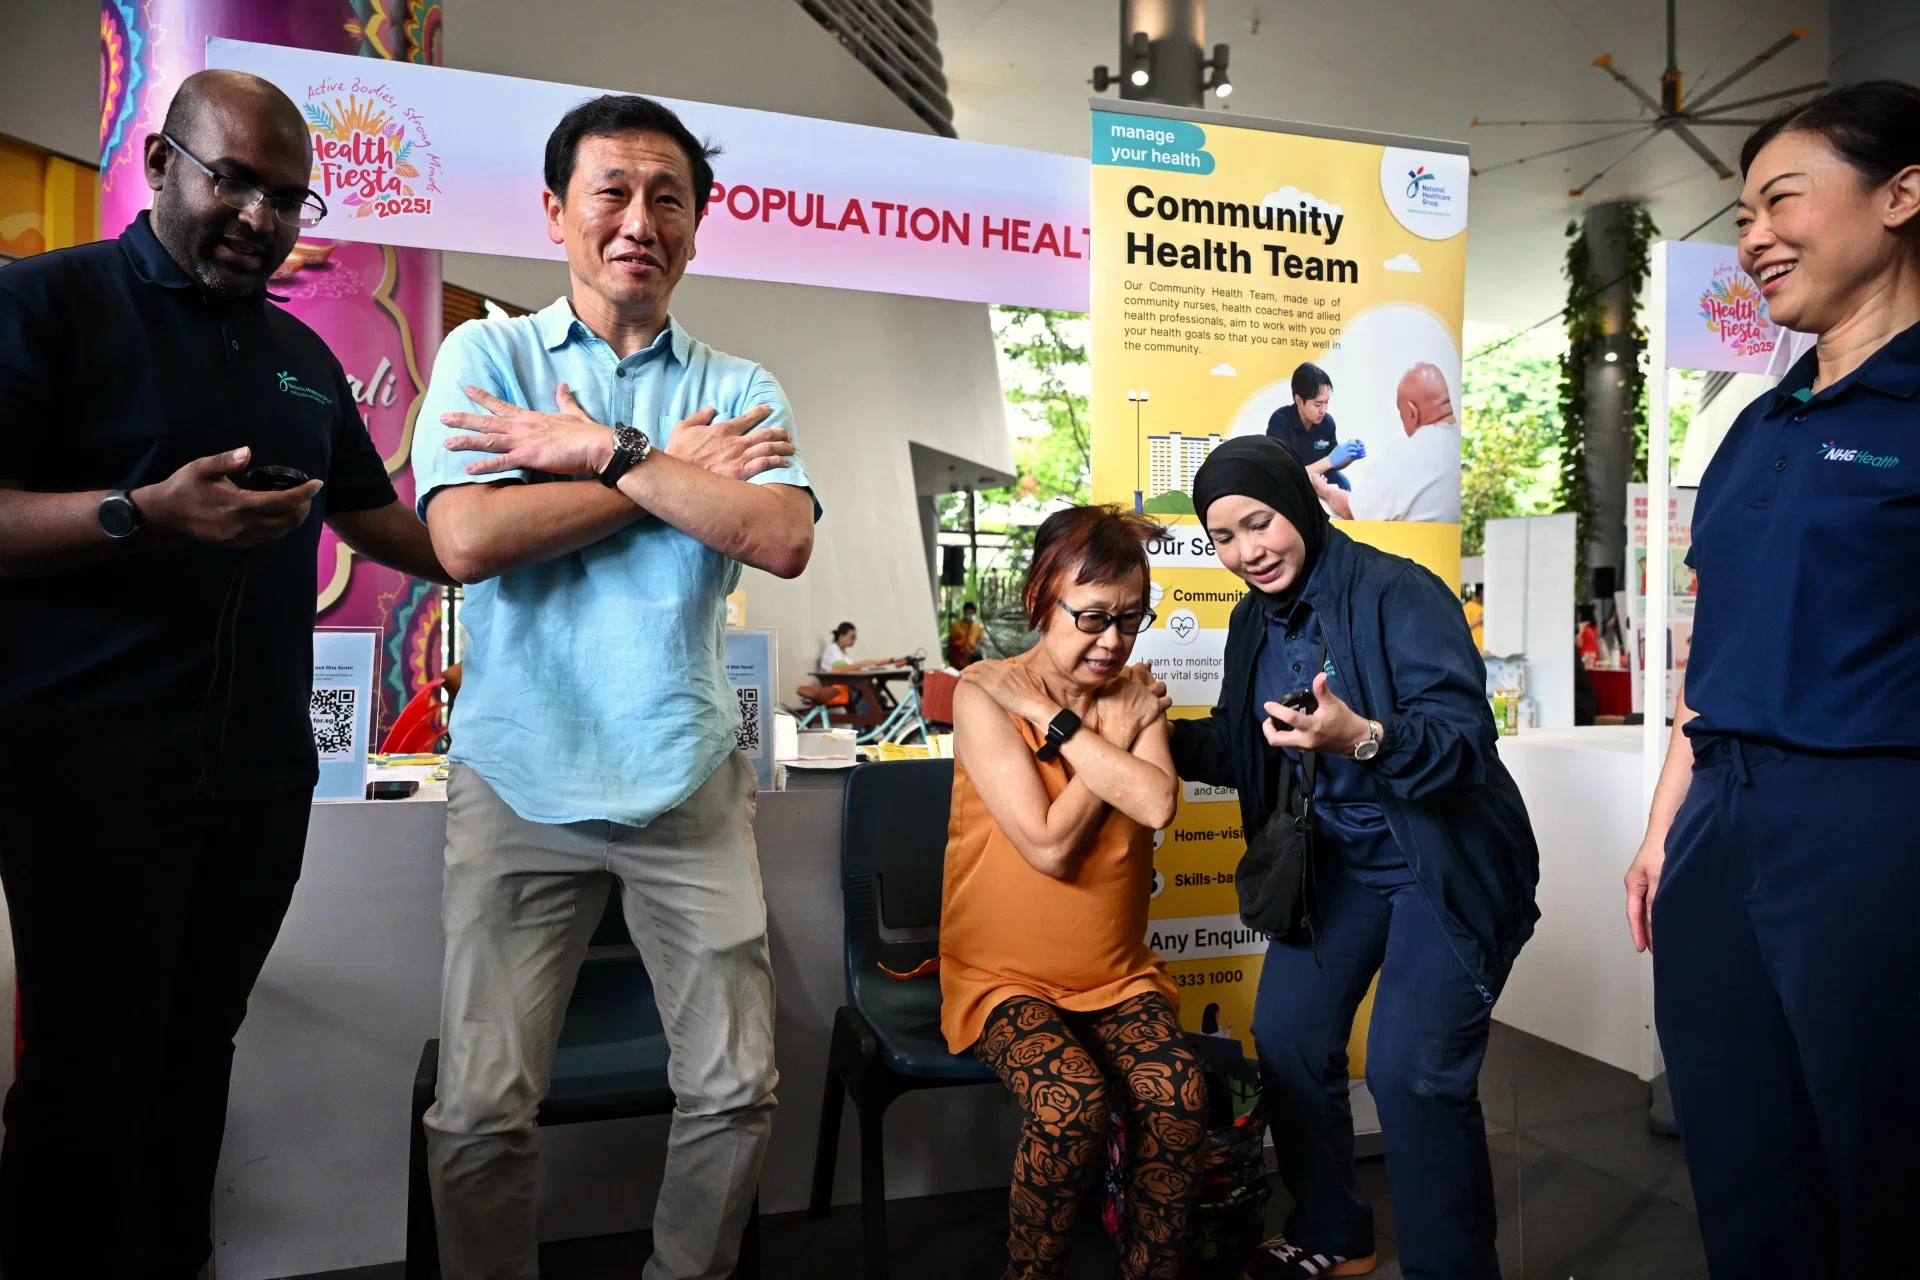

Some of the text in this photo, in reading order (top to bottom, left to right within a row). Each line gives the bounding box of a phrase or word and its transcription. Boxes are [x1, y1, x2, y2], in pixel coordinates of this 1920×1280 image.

[308, 77, 444, 194] Active Bodies, Strong Minds
[1110, 123, 1175, 145] manage
[1110, 146, 1201, 168] your health
[321, 162, 402, 198] Fiesta
[374, 197, 432, 218] 2025!
[704, 181, 971, 247] POPULATION
[1126, 185, 1344, 245] Community
[1126, 232, 1359, 285] Health Team
[1124, 280, 1341, 307] Our Community Health Team, made up of
[1124, 297, 1341, 322] community nurses, health coaches and allied
[1709, 298, 1756, 323] Health
[1124, 311, 1341, 336] health professionals, aim to work with you on
[1720, 319, 1761, 342] Fiesta
[1124, 326, 1341, 350] your health goals so that you can stay well in
[1124, 341, 1202, 356] the community.
[1146, 538, 1184, 556] Our
[1173, 657, 1183, 667] to
[1186, 657, 1222, 667] monitor
[1151, 670, 1219, 682] our vital signs
[1194, 786, 1235, 796] and care
[1175, 872, 1236, 886] Skills-ba
[1149, 928, 1270, 953] Any Enquiri
[1208, 969, 1243, 984] 1000
